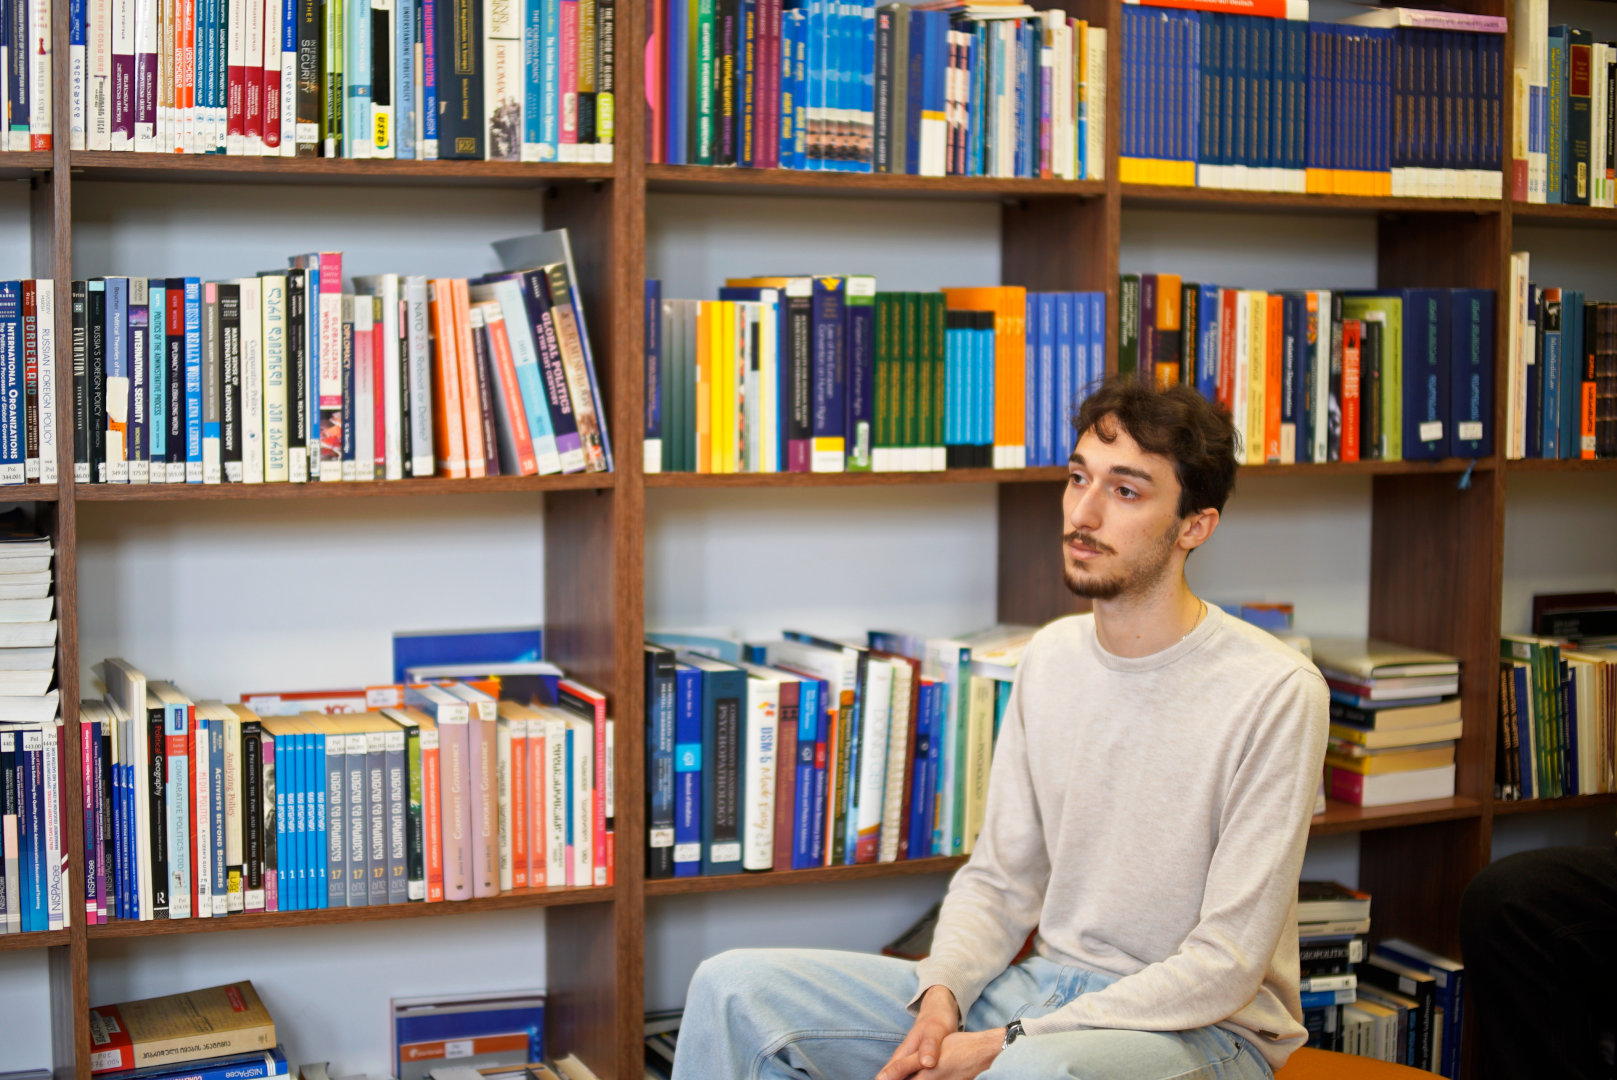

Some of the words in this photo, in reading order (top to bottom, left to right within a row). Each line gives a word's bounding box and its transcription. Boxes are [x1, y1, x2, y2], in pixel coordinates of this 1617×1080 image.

[526, 28, 532, 38] OF
[301, 40, 310, 93] SECURITY
[546, 47, 554, 63] United
[605, 54, 612, 62] OF
[496, 45, 506, 103] DIPLOMACY
[546, 65, 554, 81] States
[546, 82, 554, 92] and
[545, 93, 553, 114] Coercive
[544, 115, 553, 141] Diplomacy
[186, 283, 198, 300] HOW
[323, 299, 329, 309] OF
[186, 302, 199, 330] RUSSIA
[414, 302, 423, 331] NATO
[536, 325, 543, 333] IN
[7, 322, 17, 388] INTERNATIONAL
[26, 316, 37, 395] BORDERLAND
[42, 328, 50, 366] RUSSIAN
[74, 328, 84, 376] EVALUATION
[187, 332, 199, 364] REALLY
[415, 335, 425, 353] 2.0:
[538, 334, 546, 350] THE
[114, 360, 120, 368] of
[134, 330, 143, 387] INTERNATIONAL
[249, 340, 258, 388] Comparative
[416, 356, 426, 391] Reboot
[541, 352, 549, 369] 21ST
[541, 312, 558, 359] GLOBAL
[552, 361, 571, 414] POLITICS
[565, 324, 590, 408] CRIMINOLOGY
[1345, 347, 1358, 398] BELARUS
[42, 370, 51, 409] FOREIGN
[187, 366, 199, 392] WORKS
[232, 376, 238, 386] OF
[544, 370, 558, 405] CENTURY
[134, 388, 143, 423] SECURITY
[154, 394, 162, 415] PROCESS
[250, 391, 258, 416] Politics
[418, 394, 425, 403] or
[8, 389, 19, 459] ORGANIZATIONS
[44, 413, 52, 445] POLICY
[418, 407, 428, 441] Delete?
[154, 726, 162, 754] Political
[759, 727, 773, 763] DSM-5
[871, 708, 885, 758] DOING
[154, 756, 163, 796] Geography
[225, 752, 235, 792] Analyzing
[452, 743, 461, 793] GOVERNANCE
[717, 705, 728, 827] PSYCHOPATHOLOGY
[868, 762, 883, 791] CBT
[975, 743, 985, 800] PSYCHOLOGY
[175, 760, 183, 814] COMPARATIVE
[331, 772, 341, 804] თაფლი
[760, 767, 773, 799] Made
[199, 796, 208, 824] POLITICS
[226, 794, 236, 817] Policy
[332, 806, 341, 817] და
[454, 796, 462, 839] CORPORATE
[752, 802, 773, 829] Easy
[176, 816, 184, 851] POLITICS
[332, 819, 341, 862] ნავთობი
[216, 850, 224, 888] BORDERS
[332, 870, 341, 879] 17
[51, 865, 61, 911] NISPAcee
